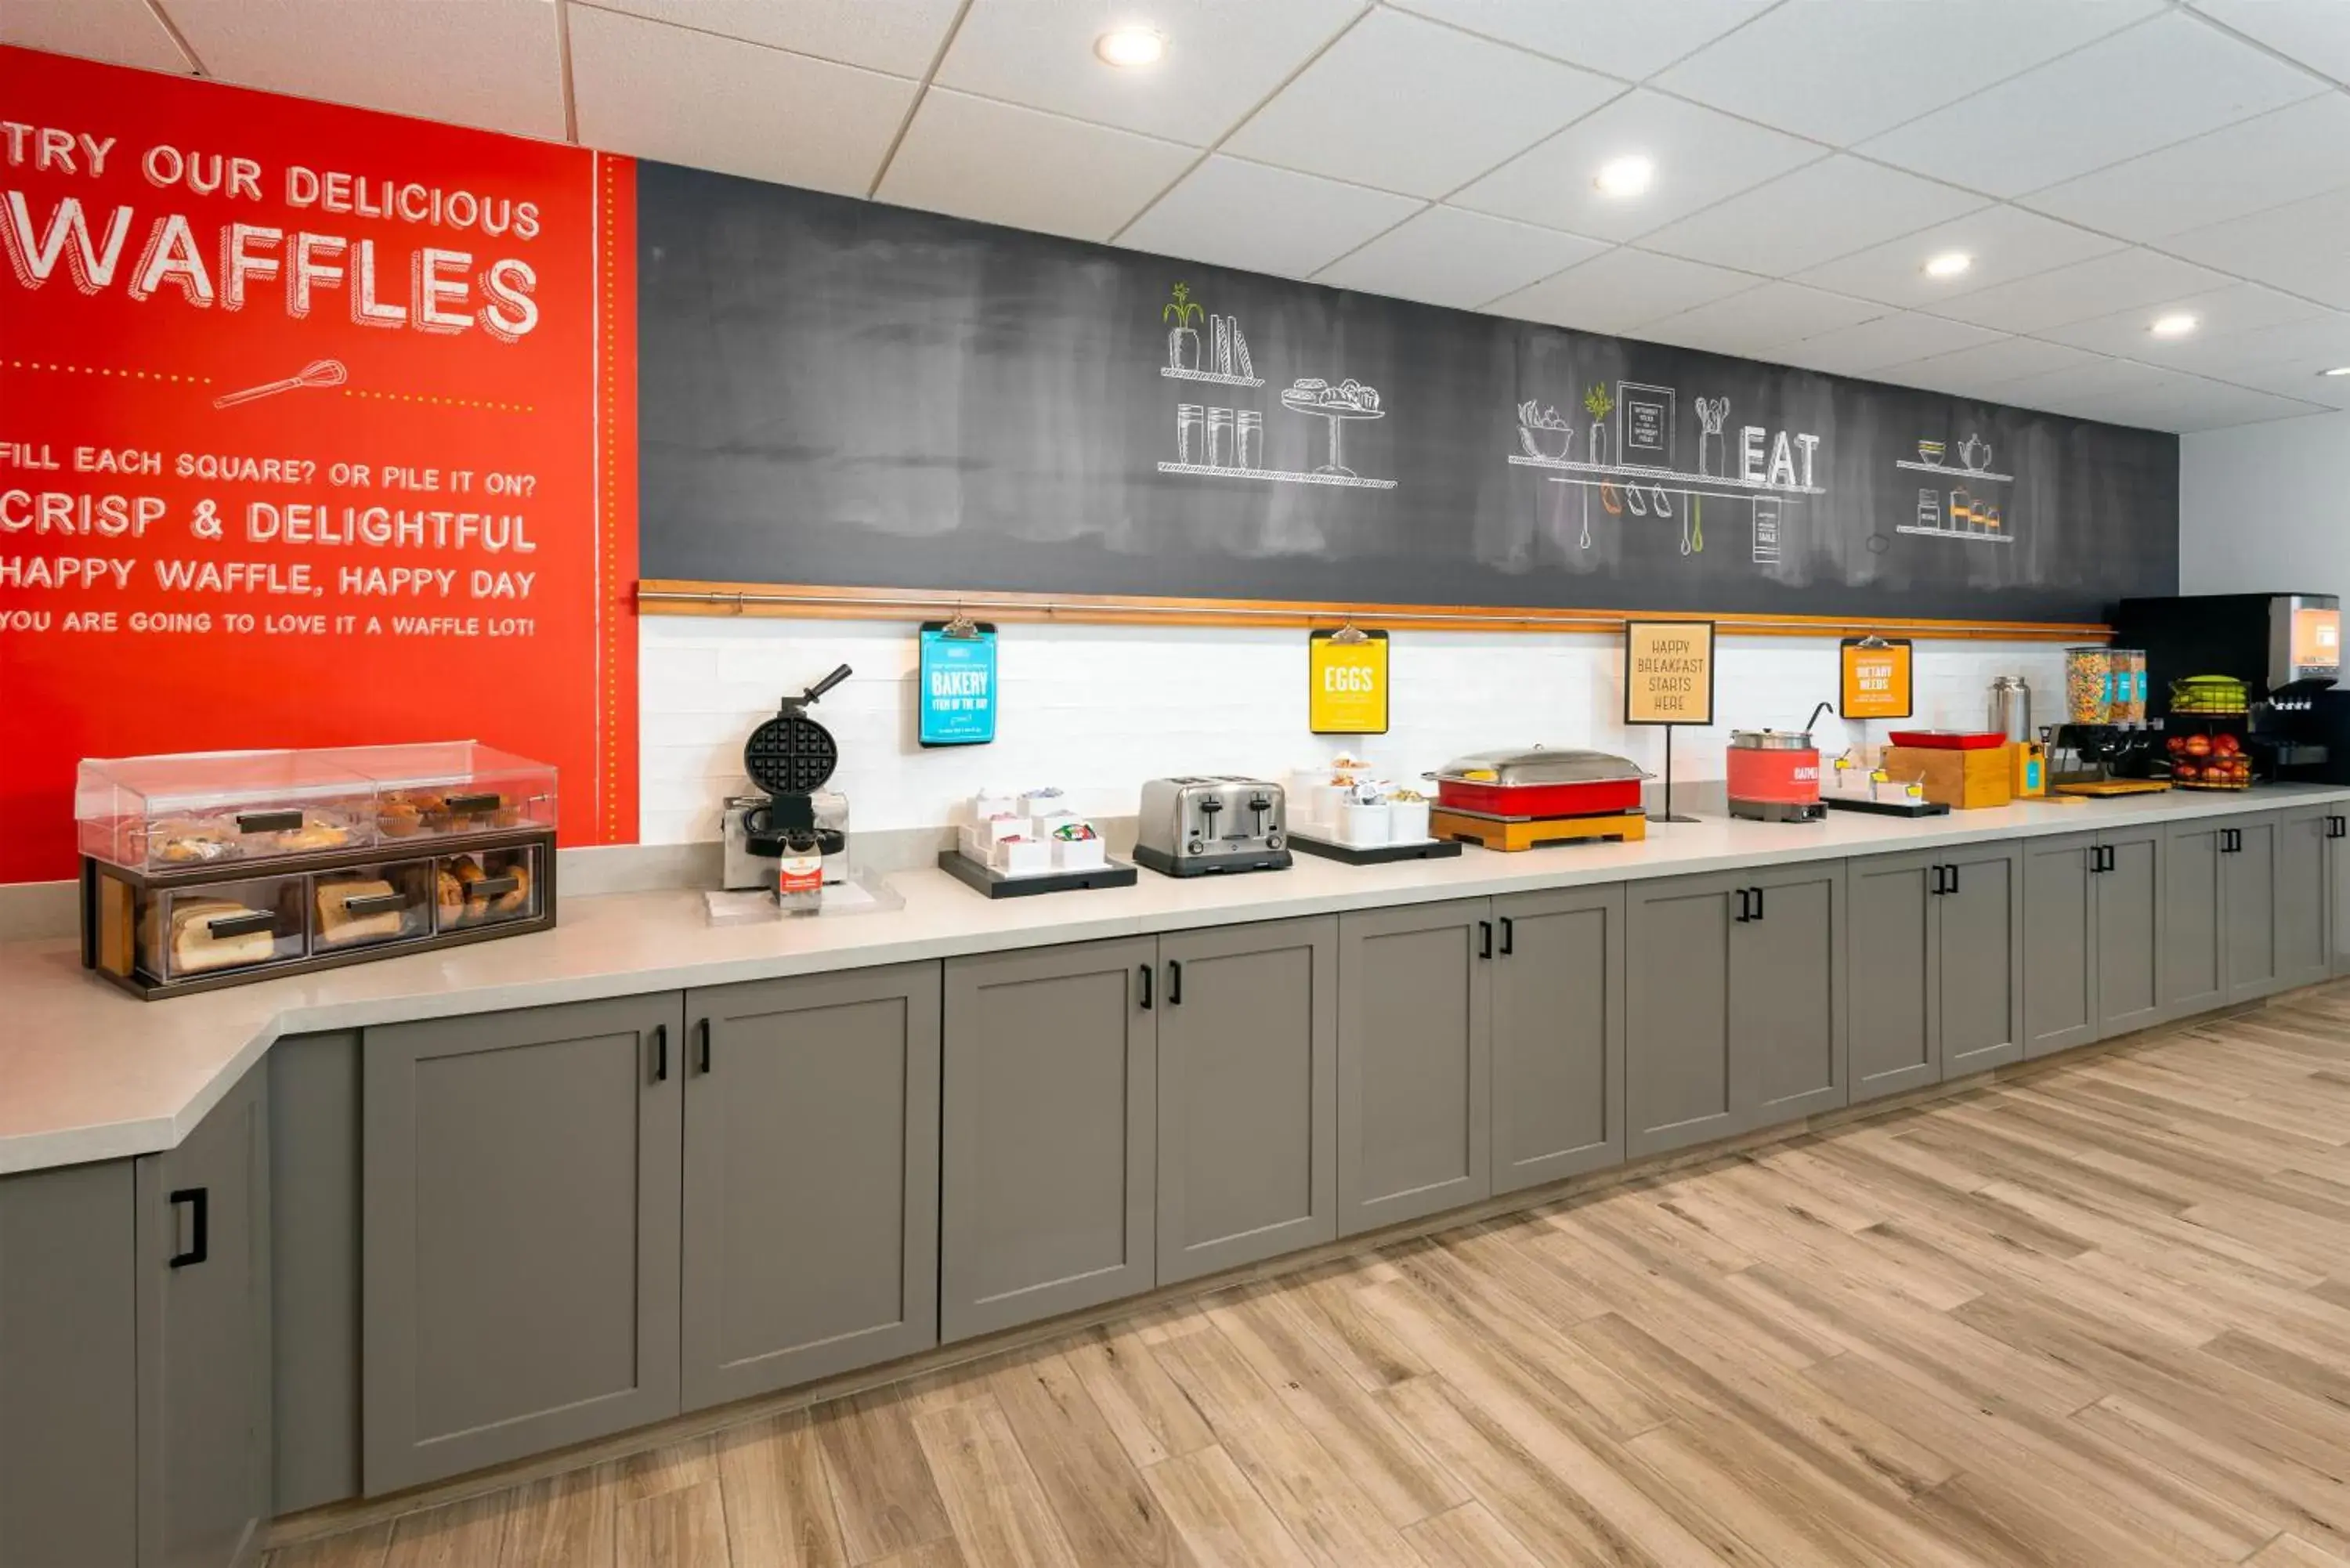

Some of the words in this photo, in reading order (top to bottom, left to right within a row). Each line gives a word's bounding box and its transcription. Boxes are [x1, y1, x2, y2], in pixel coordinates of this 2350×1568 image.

[1, 121, 117, 179] TRY
[142, 145, 262, 201] OUR
[285, 165, 540, 240] DELICIOUS
[0, 190, 539, 343] WAFFLES
[0, 441, 60, 470] FILL
[74, 446, 161, 475] EACH
[175, 453, 316, 485] SQUARE?
[329, 462, 371, 488] OR
[382, 465, 440, 492] PILE
[450, 470, 474, 493] IT
[484, 472, 537, 497] ON?
[1740, 425, 1820, 487] EAT
[0, 489, 167, 538] CRISP
[190, 498, 224, 541] &
[247, 501, 537, 554] DELIGHTFUL
[0, 555, 136, 590] HAPPY
[154, 558, 324, 598] WAFFLE,
[338, 565, 457, 598] HAPPY
[471, 569, 537, 600] DAY
[0, 610, 52, 632] YOU
[62, 611, 119, 633] ARE
[128, 611, 212, 634] GOING
[223, 613, 255, 634] TO
[265, 614, 327, 635] LOVE
[335, 616, 357, 635] IT
[365, 616, 383, 635] A
[392, 616, 481, 637] WAFFLE
[487, 618, 535, 638] LOT!
[1652, 639, 1690, 655] HAPPY
[1325, 666, 1373, 692] EGGS
[1638, 658, 1704, 674] BREAKFAST
[931, 670, 988, 696] BAKERY
[1649, 677, 1691, 692] STARTS
[1654, 695, 1686, 711] HERE
